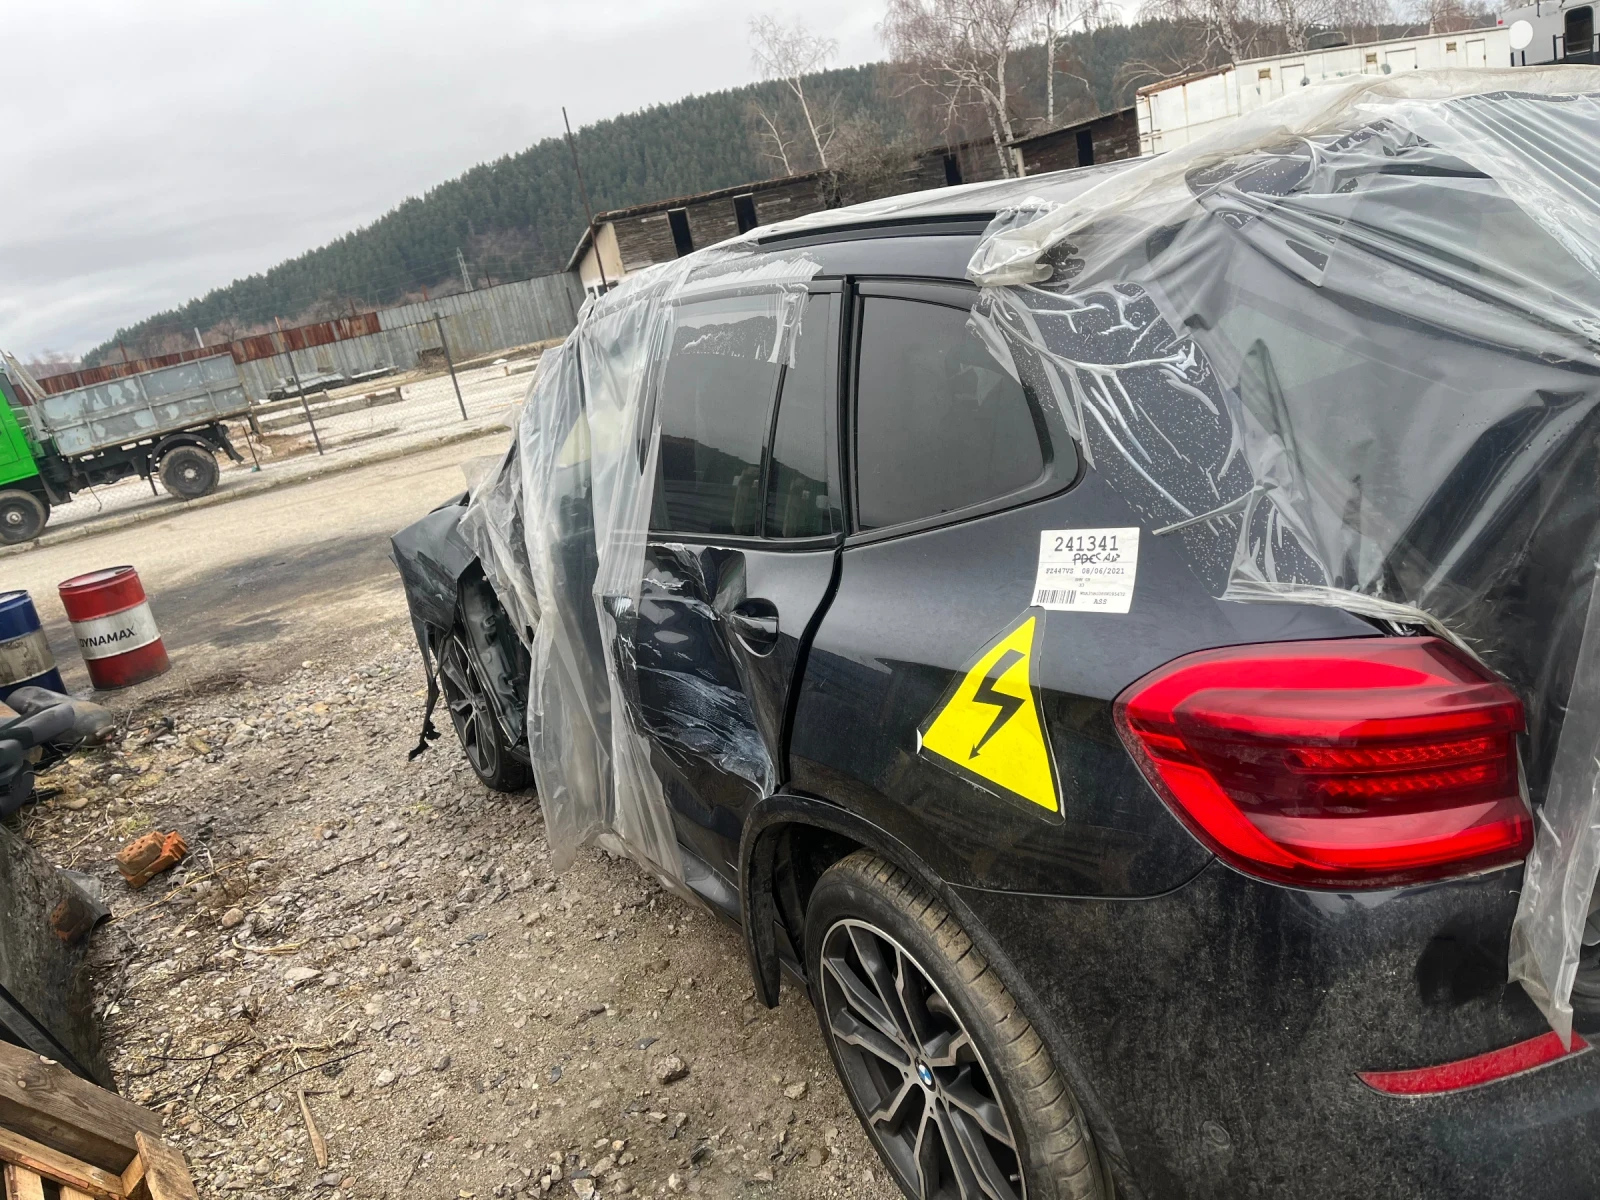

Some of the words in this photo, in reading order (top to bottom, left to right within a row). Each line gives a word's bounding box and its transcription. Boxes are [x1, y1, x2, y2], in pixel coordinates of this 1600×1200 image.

[1054, 535, 1119, 552] 241341
[1081, 567, 1125, 575] 08/06/2021
[79, 622, 136, 648] DYNAMAX
